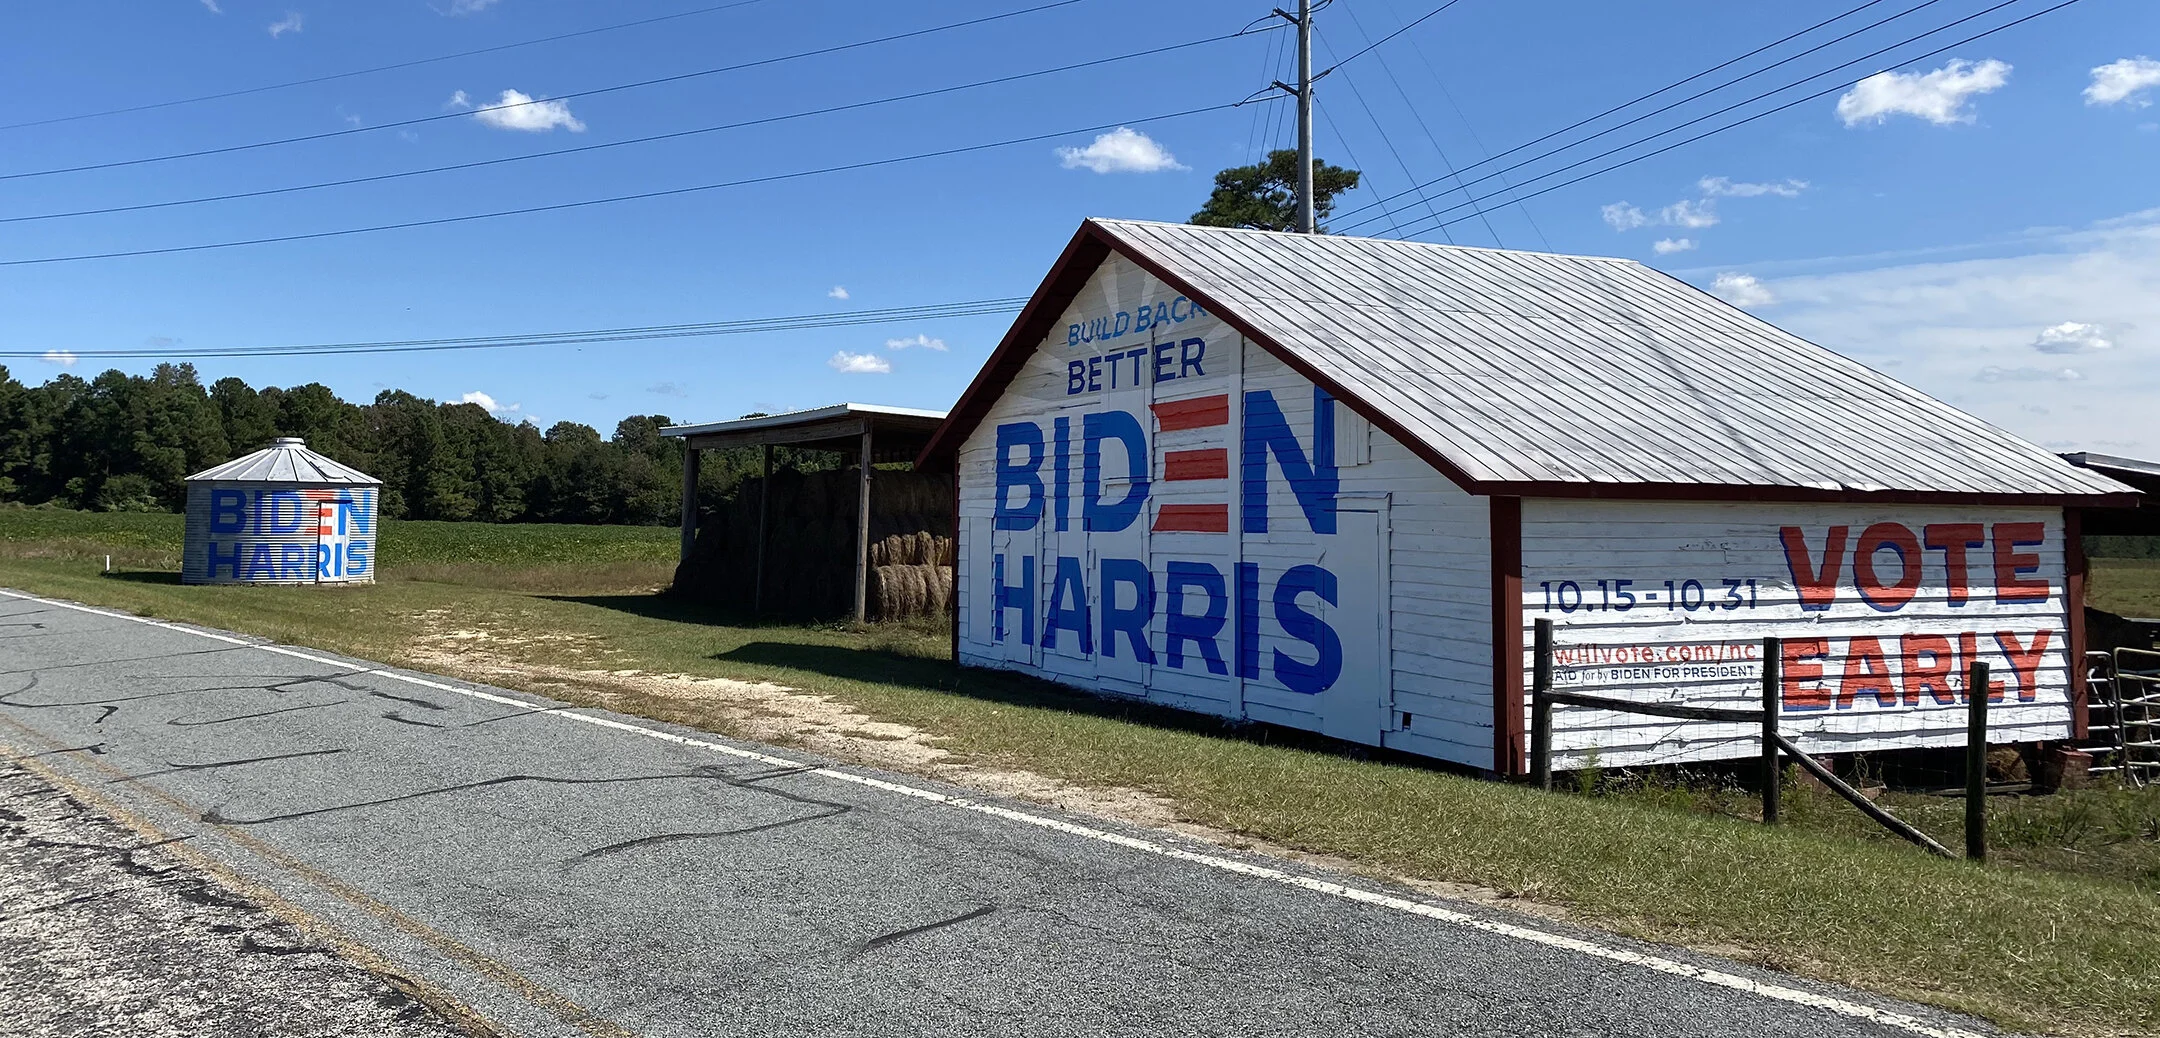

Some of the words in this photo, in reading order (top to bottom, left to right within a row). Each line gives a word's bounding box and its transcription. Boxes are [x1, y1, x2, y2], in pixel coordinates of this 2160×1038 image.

[1068, 311, 1131, 347] BUILD
[1067, 336, 1206, 396] BETTER
[995, 386, 1338, 534] BIDEN
[210, 488, 370, 536] BIDEN
[207, 540, 367, 580] HARRIS
[1779, 522, 2050, 612] VOTE
[994, 554, 1343, 695] HARRIS
[1554, 670, 1577, 681] AID
[1610, 668, 1650, 680] BIDEN
[1654, 667, 1680, 679] FOR
[1683, 665, 1755, 678] PRESIDENT
[1781, 630, 2053, 712] EARLY
